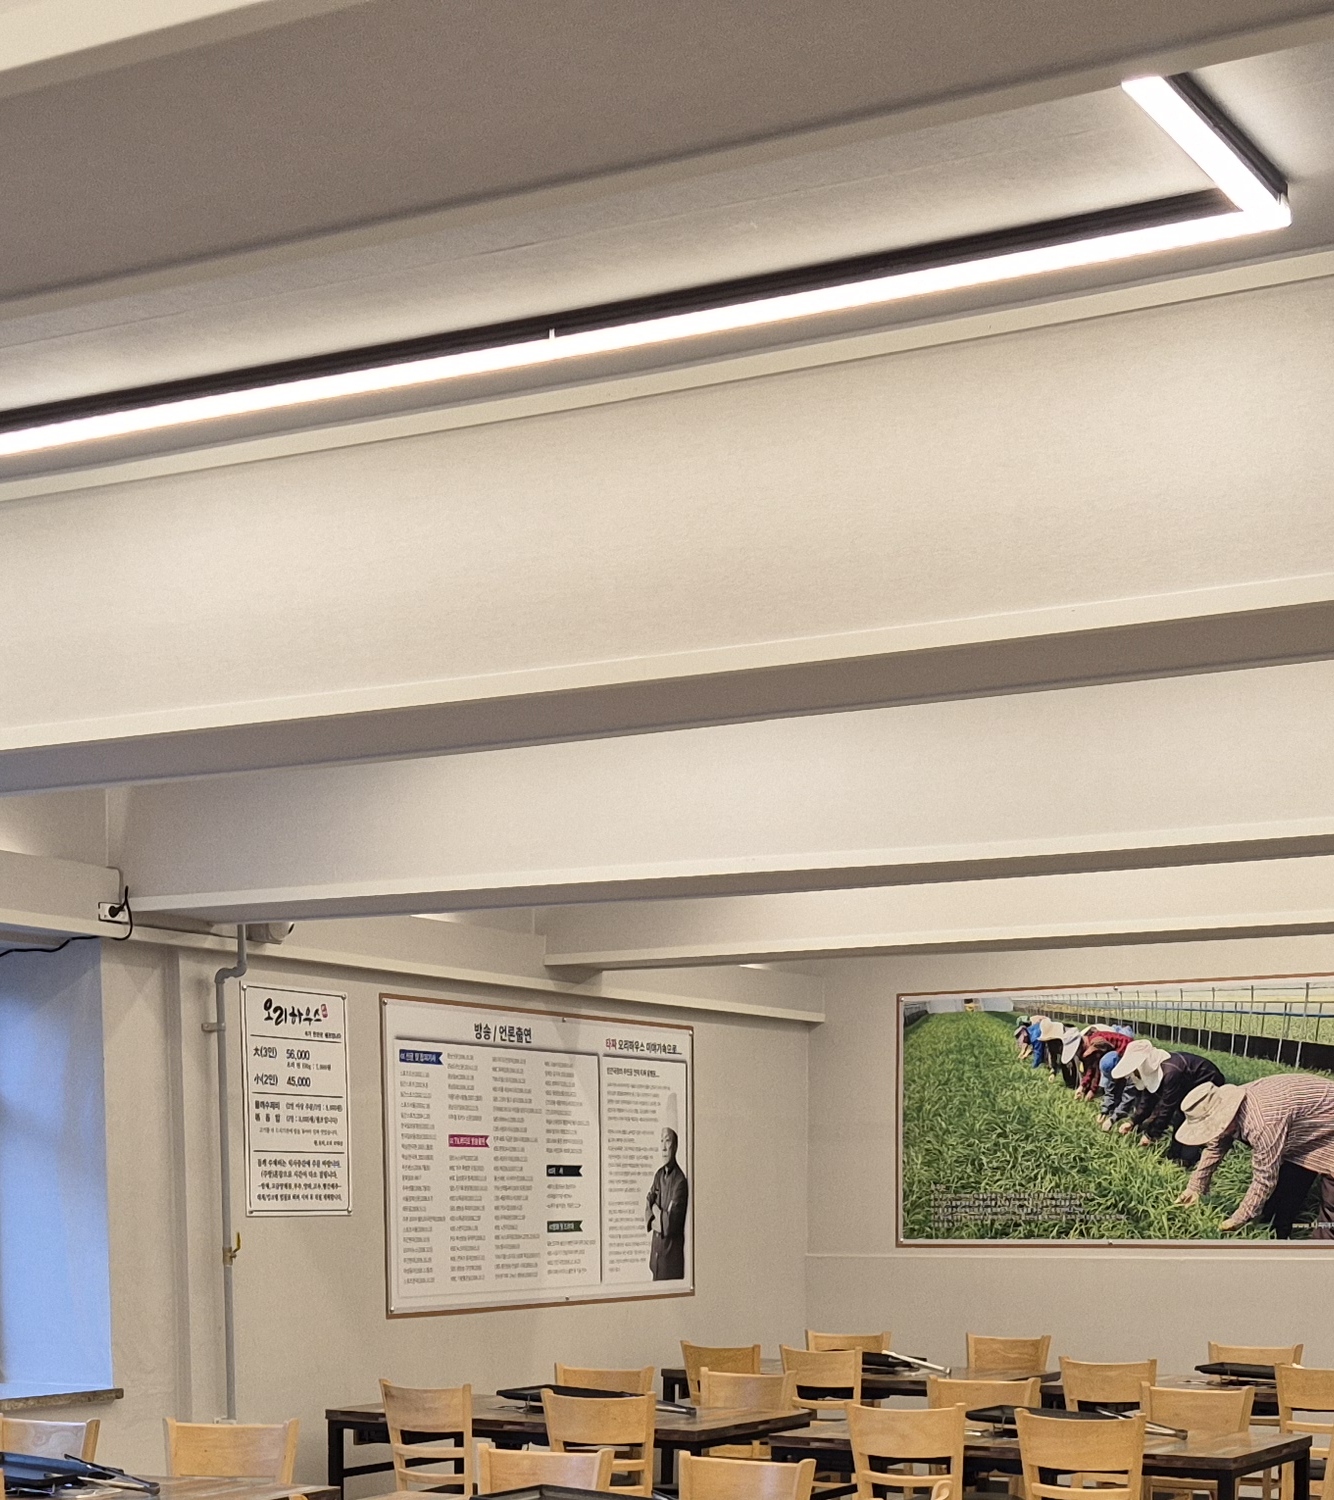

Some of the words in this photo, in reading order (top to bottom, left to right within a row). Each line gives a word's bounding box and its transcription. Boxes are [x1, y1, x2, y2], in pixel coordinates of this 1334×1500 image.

[263, 997, 323, 1027] 오리하우스
[474, 1022, 492, 1040] 방송
[498, 1025, 532, 1044] 언론출연
[286, 1049, 310, 1061] 56,000
[286, 1076, 311, 1088] 45,000
